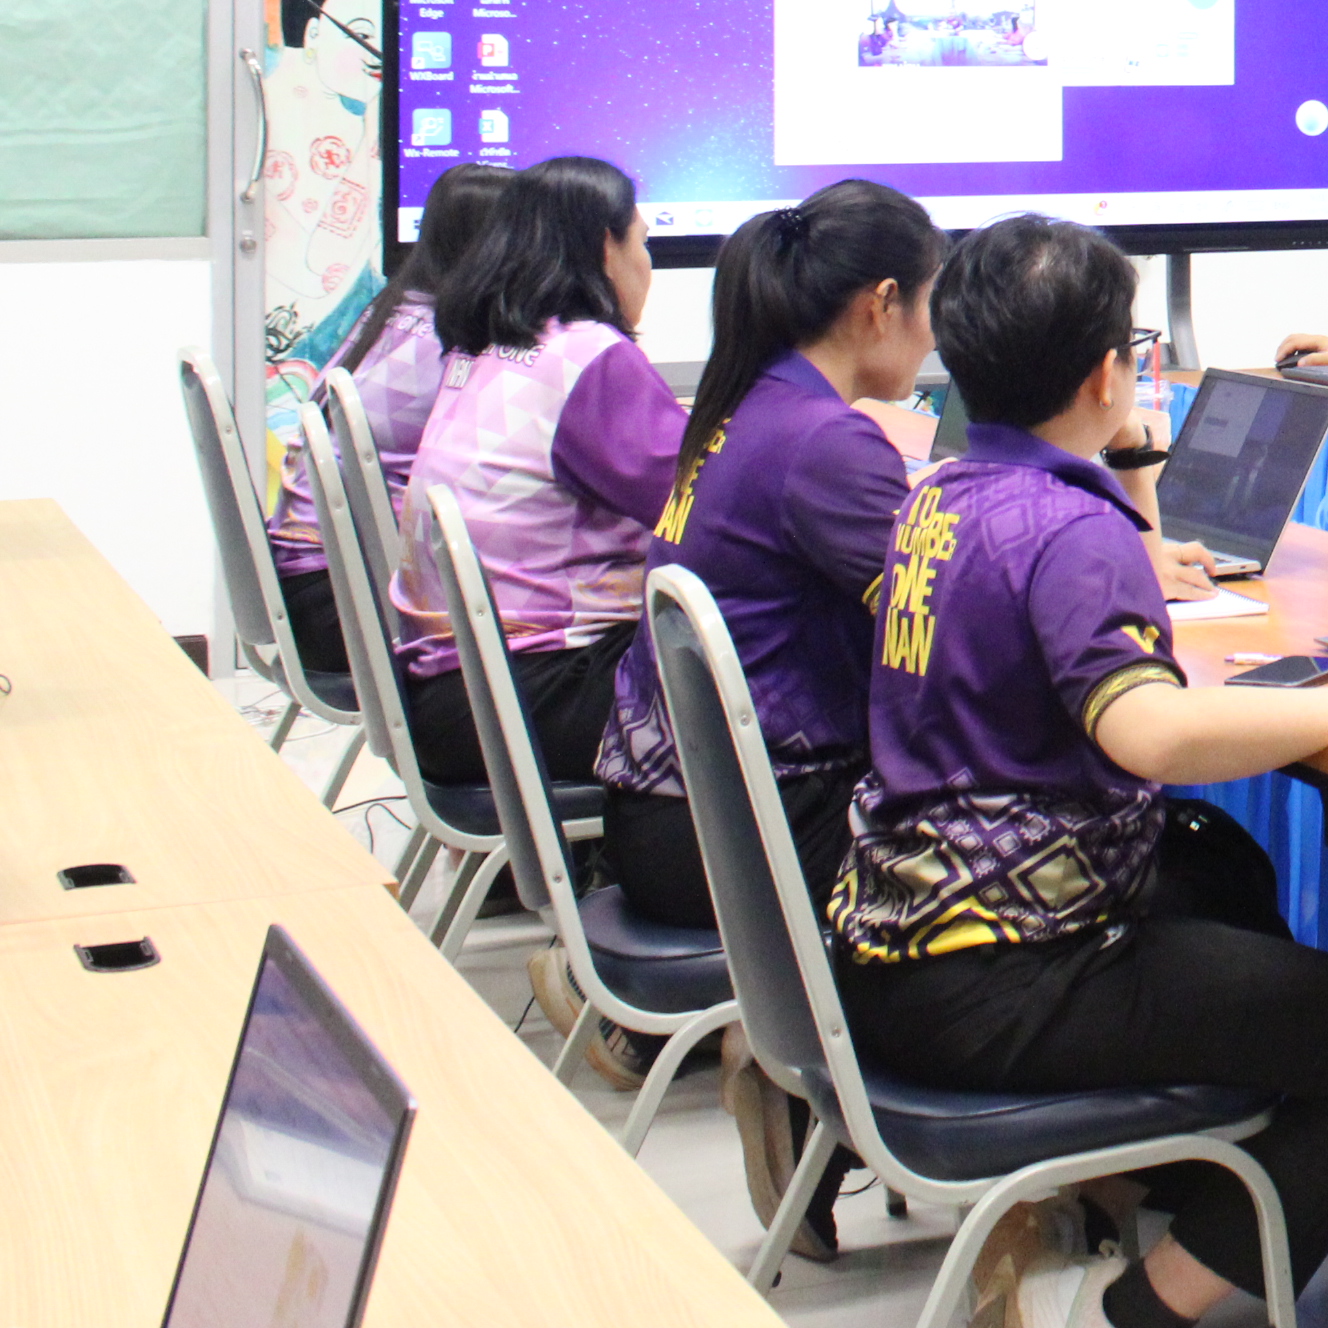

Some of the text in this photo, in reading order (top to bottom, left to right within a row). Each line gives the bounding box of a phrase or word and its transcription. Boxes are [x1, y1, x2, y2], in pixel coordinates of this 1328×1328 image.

[419, 8, 445, 19] Edge
[891, 554, 937, 615] ONE
[882, 606, 936, 677] NAN
